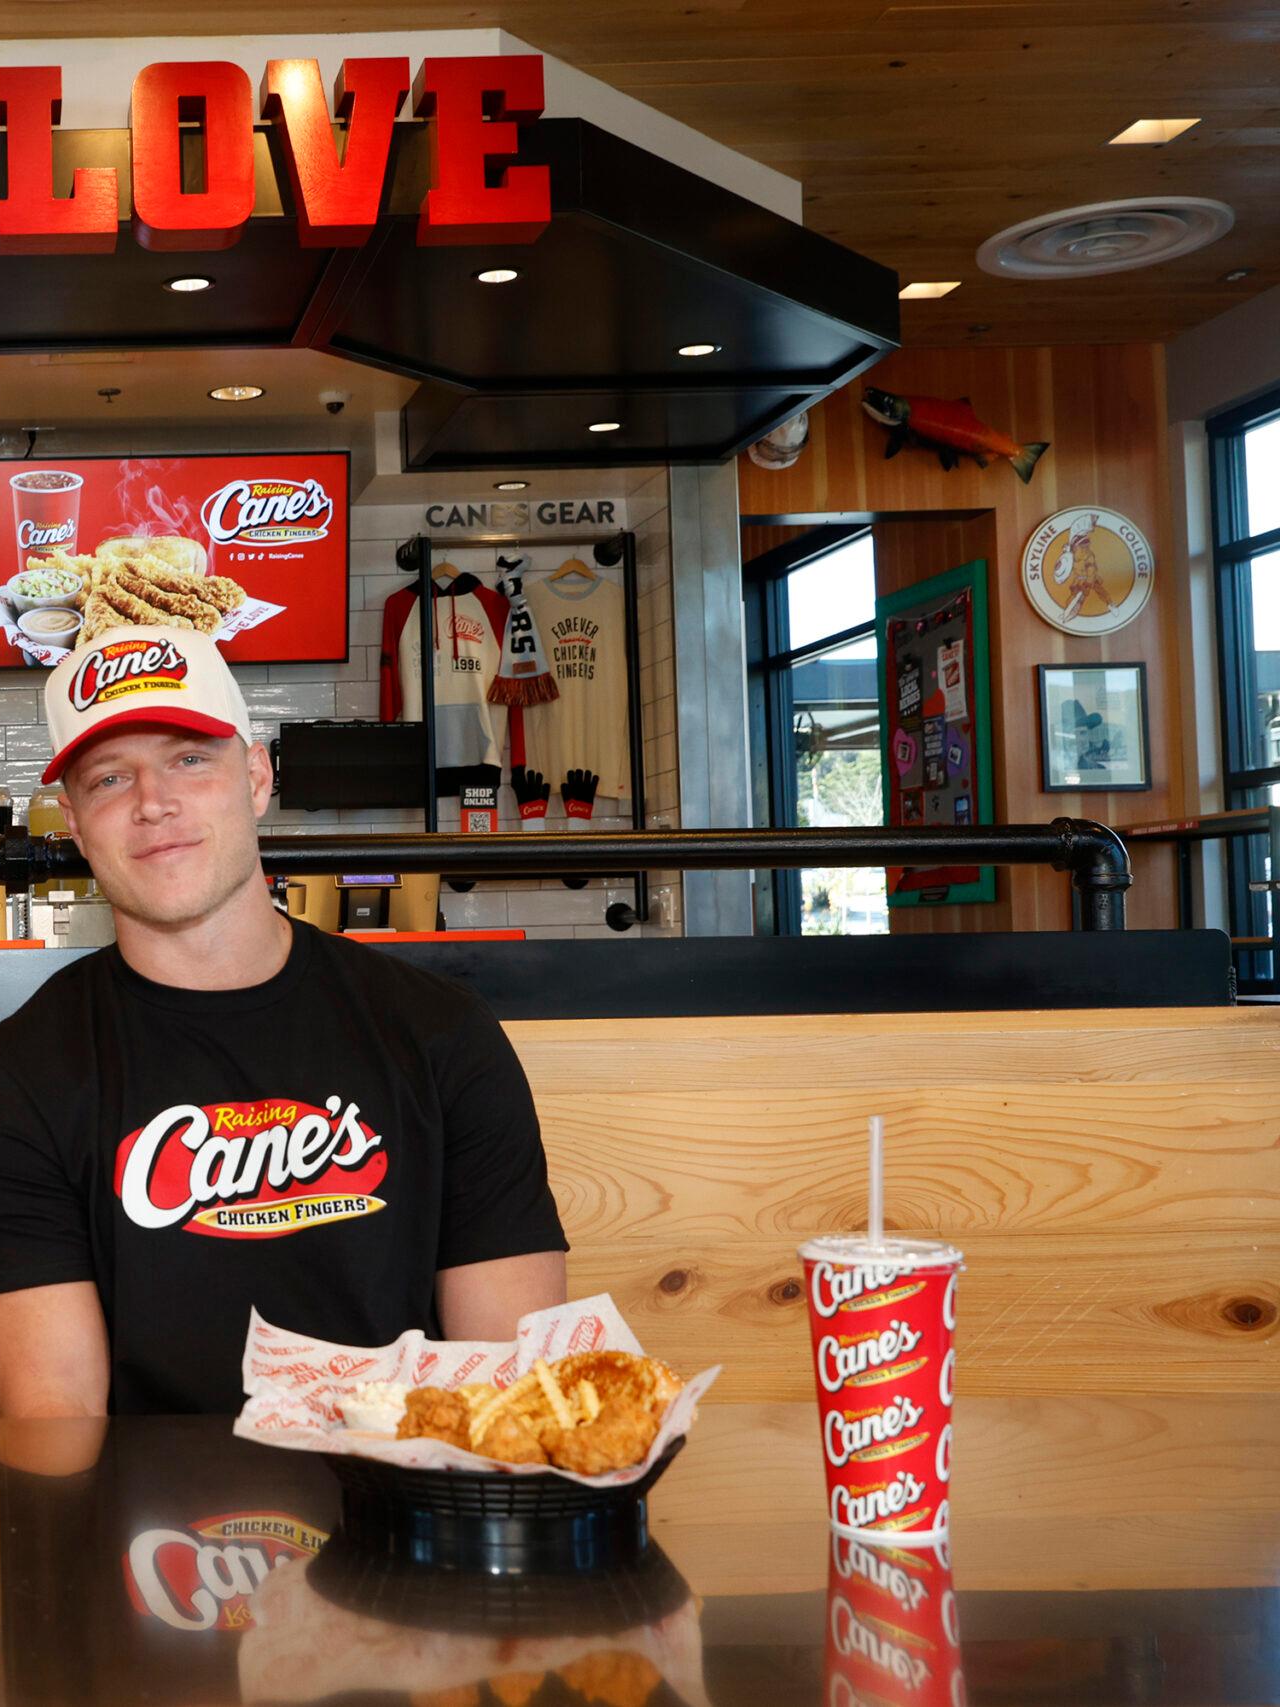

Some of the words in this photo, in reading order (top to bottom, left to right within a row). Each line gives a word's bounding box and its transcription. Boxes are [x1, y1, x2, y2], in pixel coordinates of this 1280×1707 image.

[251, 484, 294, 497] Raising
[209, 479, 331, 540] Cane's
[425, 503, 530, 528] CANE'S
[537, 501, 615, 521] GEAR
[17, 518, 76, 549] Cane's
[249, 529, 281, 538] CHICKEN
[1029, 524, 1057, 581] SKYLINE
[1119, 525, 1149, 578] COLLEGE
[551, 616, 600, 641] FOREVER
[105, 641, 148, 659] Raising
[553, 643, 597, 663] CHICKEN
[74, 638, 186, 712] Cane's
[556, 661, 595, 680] FINGERS
[104, 682, 141, 699] CHICKEN
[463, 797, 495, 806] ONLINE
[465, 788, 494, 798] SHOP
[214, 1103, 297, 1132] Raising
[121, 1095, 382, 1229] Cane's
[216, 1210, 290, 1226] CHICKEN
[295, 1198, 368, 1219] FINGERS
[818, 1319, 922, 1392] Cane's
[824, 1394, 924, 1467] Cane's
[831, 1471, 926, 1529] Cane's
